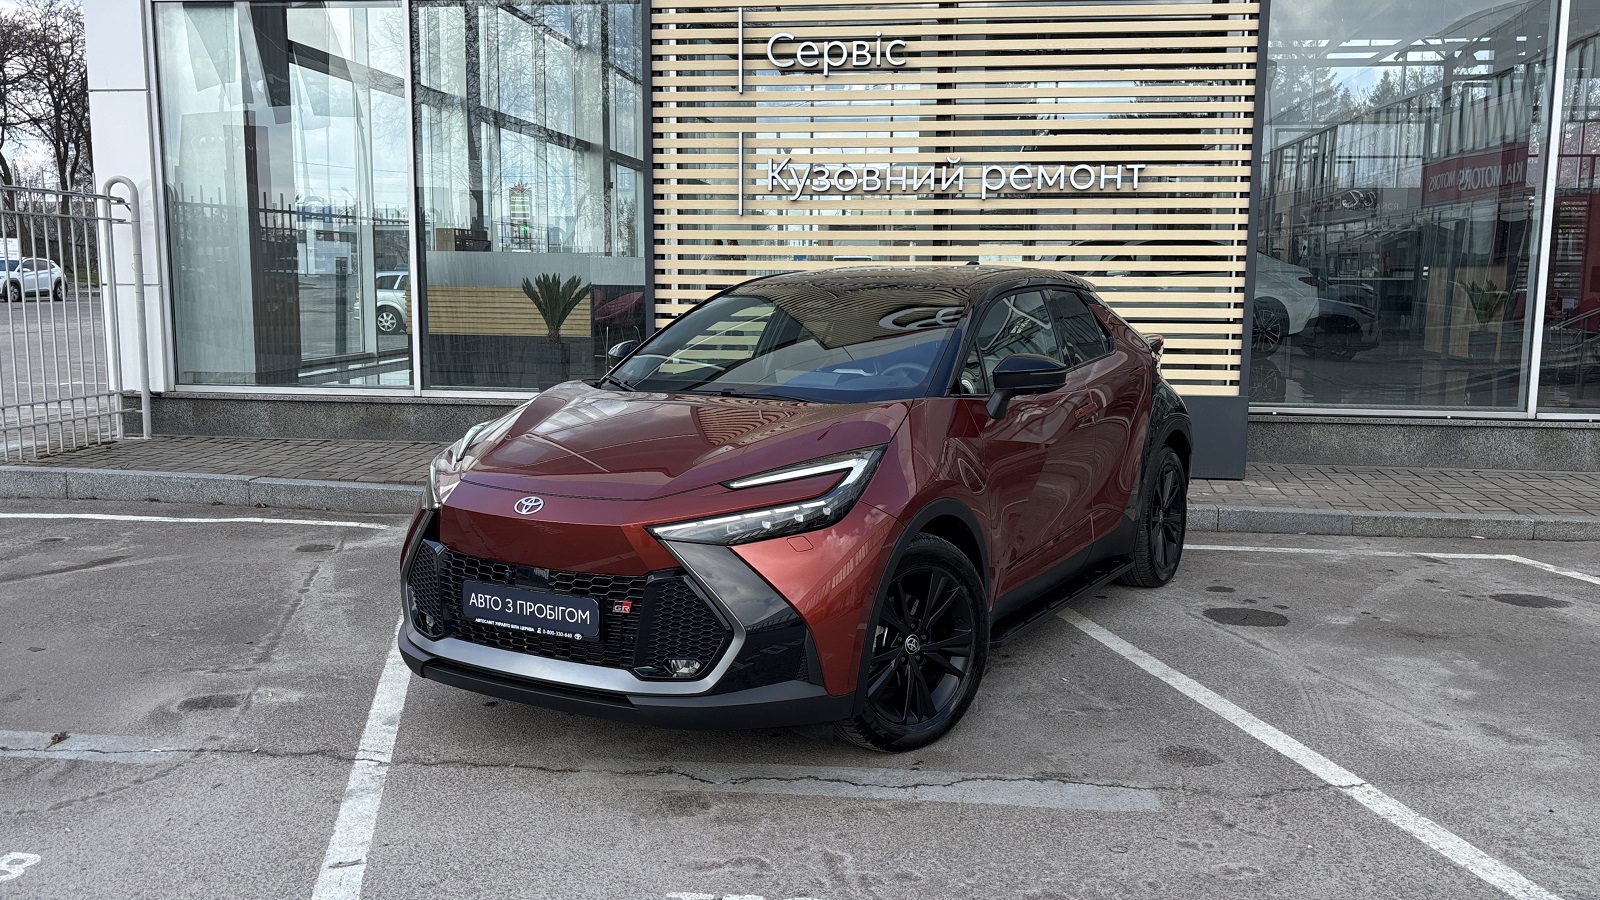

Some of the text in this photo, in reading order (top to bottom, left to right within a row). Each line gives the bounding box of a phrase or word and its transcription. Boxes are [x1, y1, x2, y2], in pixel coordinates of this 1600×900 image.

[766, 31, 907, 77] Сервіс
[766, 156, 1147, 201] Кузовний ремонт
[469, 592, 502, 611] АВТО
[517, 600, 590, 625] ПРОБІГОМ
[613, 604, 631, 613] GR
